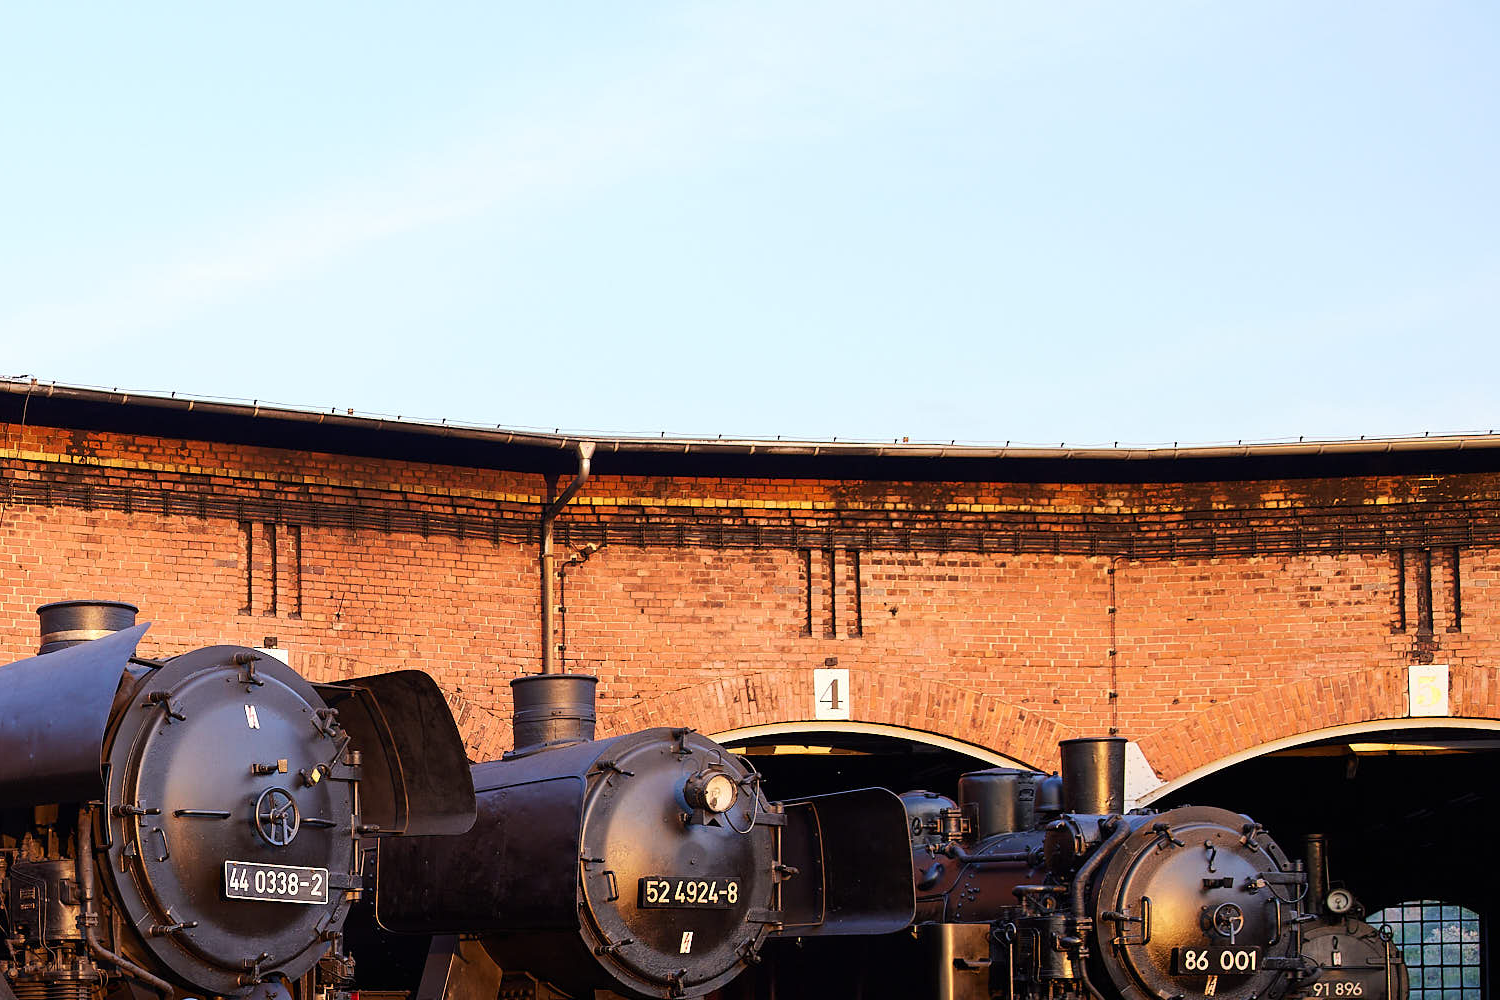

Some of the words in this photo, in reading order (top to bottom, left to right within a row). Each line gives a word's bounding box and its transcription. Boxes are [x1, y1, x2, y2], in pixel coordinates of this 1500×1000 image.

[819, 678, 844, 710] 4
[1416, 675, 1443, 707] 5
[229, 867, 250, 892] 44
[254, 870, 323, 897] 0338-2
[646, 880, 671, 903] 52
[674, 880, 738, 904] 4924-8
[1184, 950, 1209, 971] 86
[1219, 950, 1257, 971] 001
[1312, 982, 1330, 997] 91
[1334, 981, 1363, 997] 896
